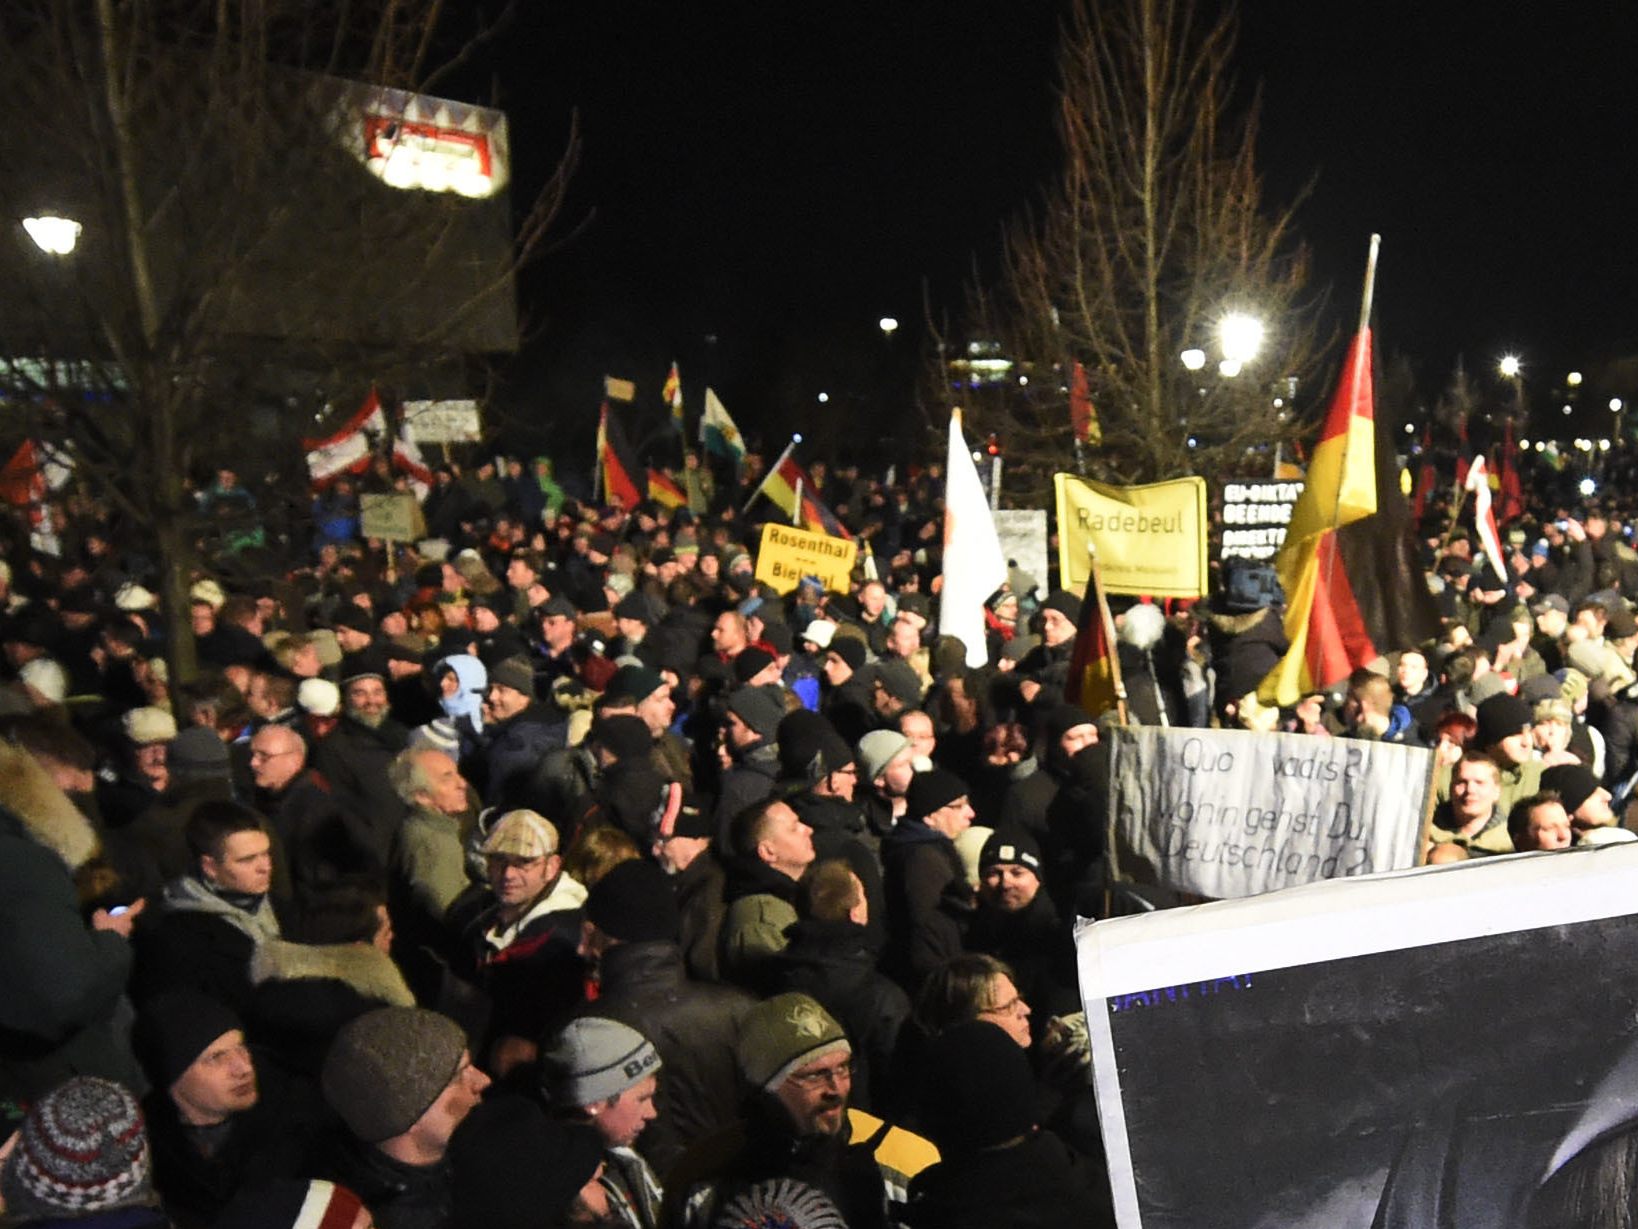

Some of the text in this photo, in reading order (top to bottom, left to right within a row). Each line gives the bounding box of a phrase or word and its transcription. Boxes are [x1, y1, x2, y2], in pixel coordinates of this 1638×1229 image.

[1224, 482, 1304, 502] EU-DIKTA
[1077, 507, 1183, 534] Radebeul
[769, 527, 849, 558] Rosenthal
[772, 562, 834, 589] Bielal
[1182, 737, 1234, 775] Quo
[1244, 798, 1323, 836] gehst
